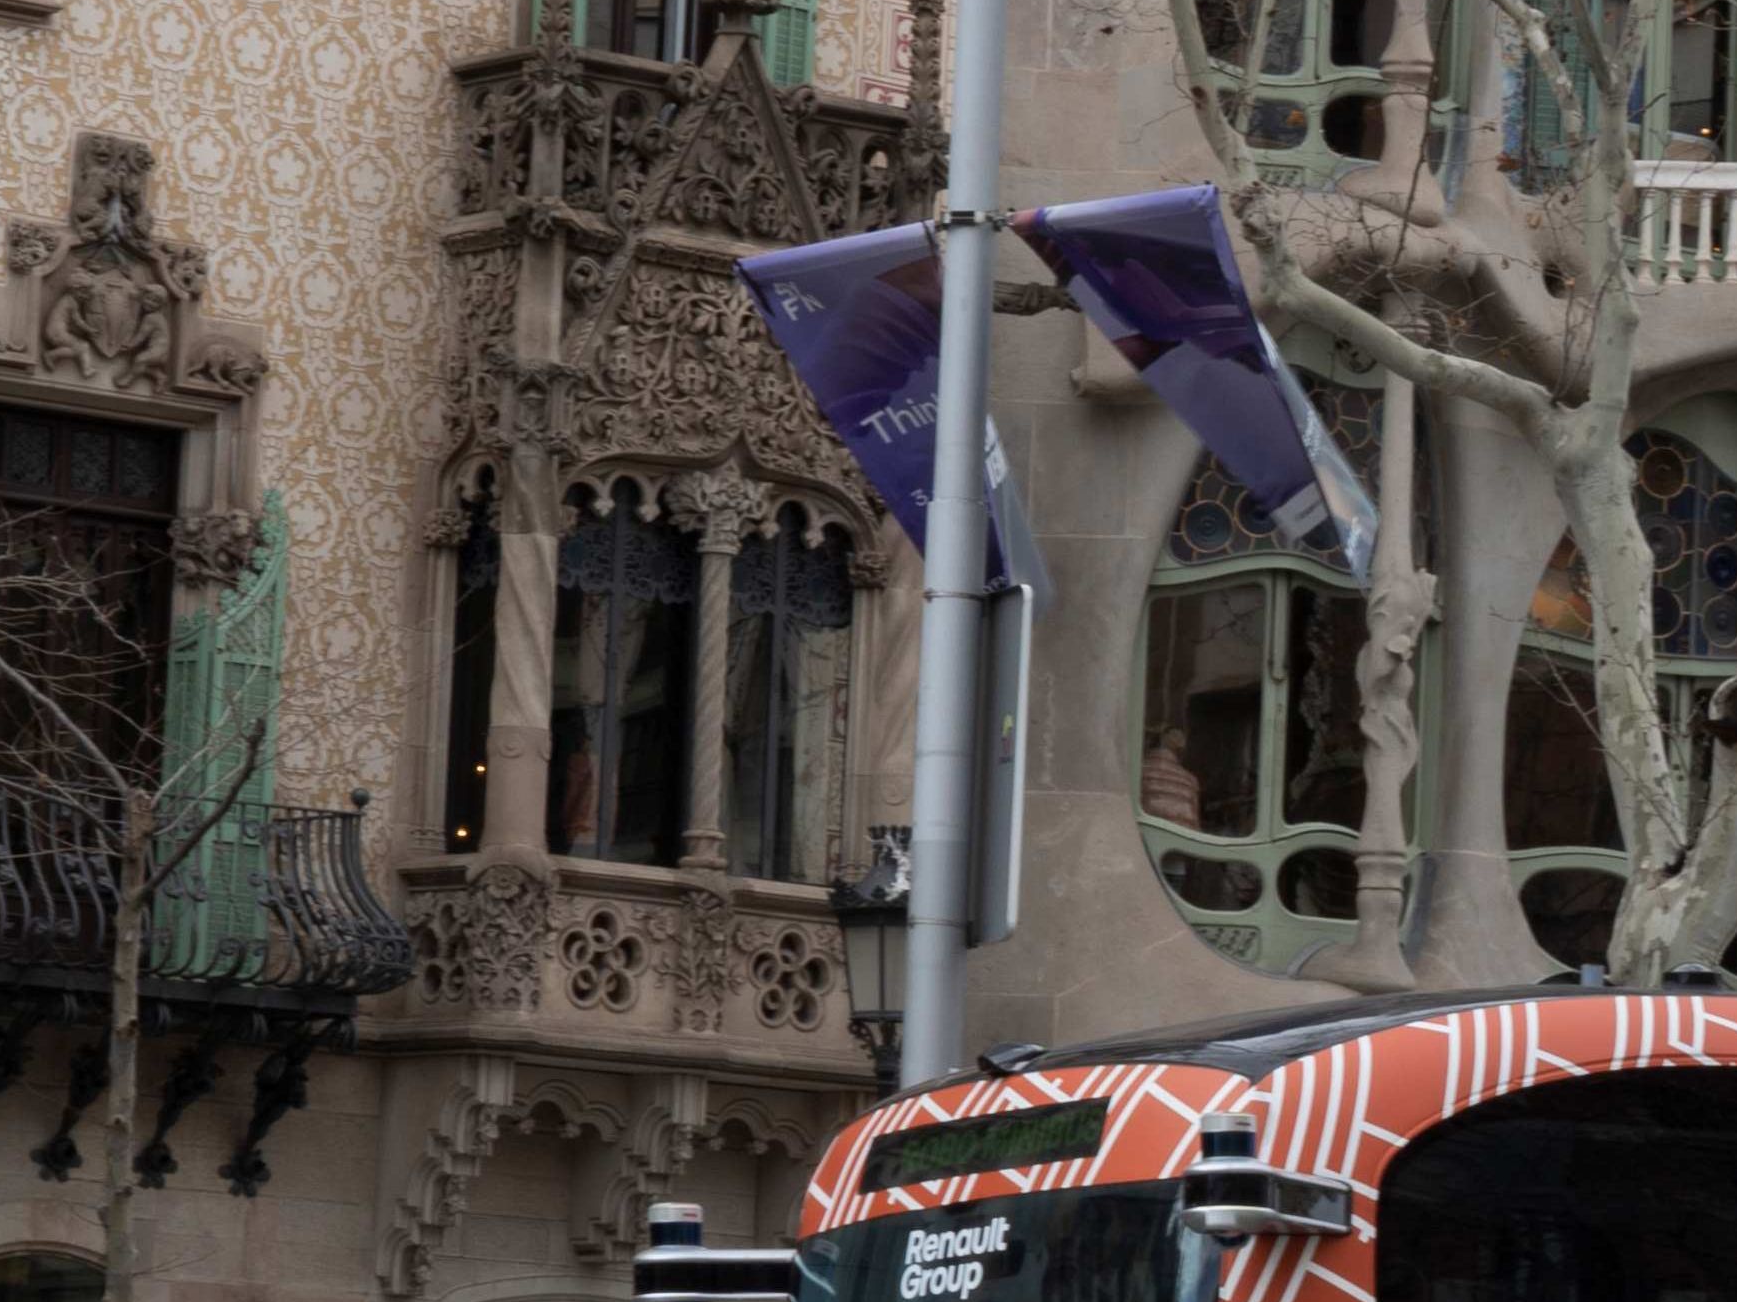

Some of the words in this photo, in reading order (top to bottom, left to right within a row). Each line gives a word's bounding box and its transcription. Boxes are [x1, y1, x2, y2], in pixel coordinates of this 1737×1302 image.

[859, 393, 937, 444] Thin
[904, 1217, 1010, 1264] Renault
[900, 1261, 984, 1299] Group
